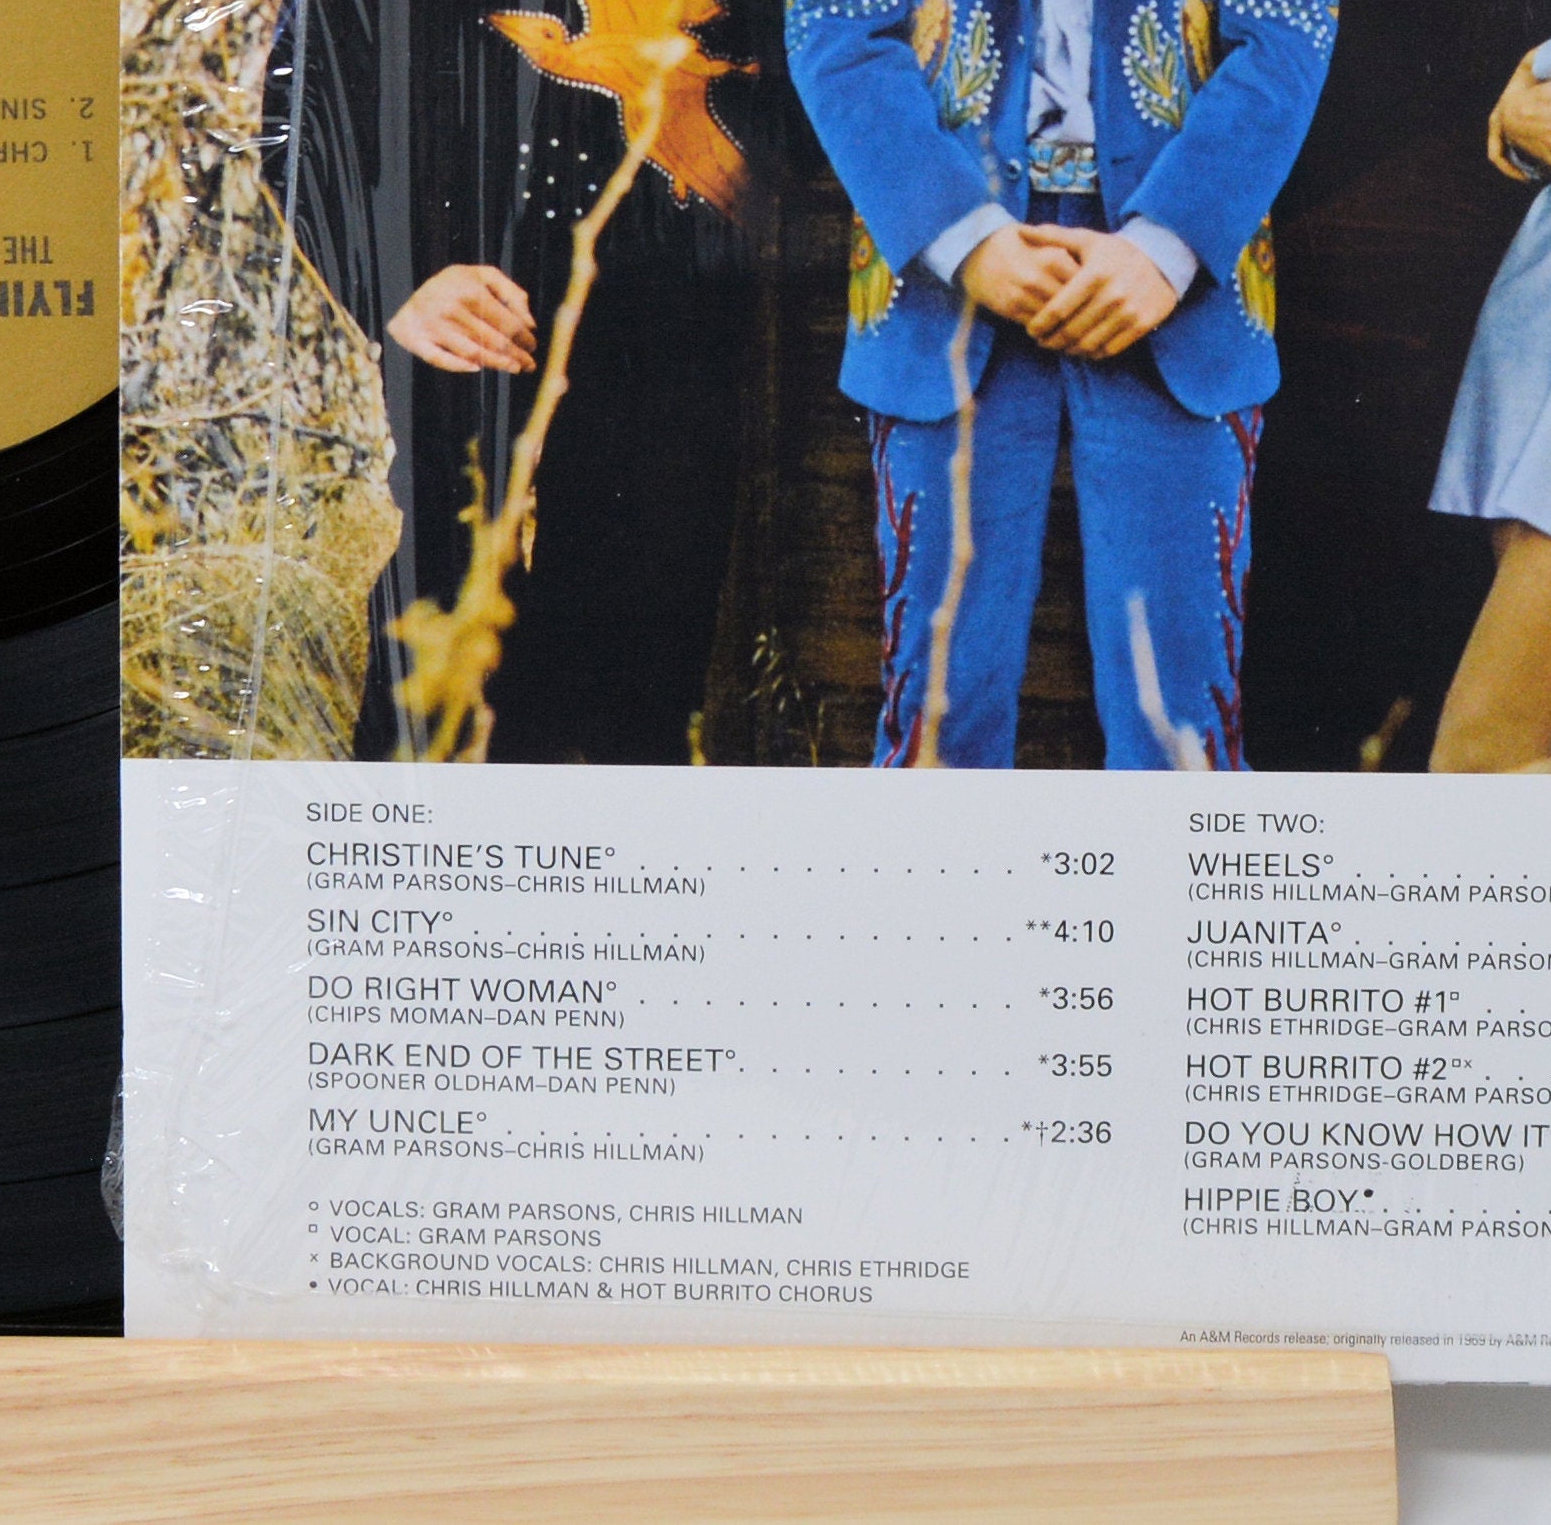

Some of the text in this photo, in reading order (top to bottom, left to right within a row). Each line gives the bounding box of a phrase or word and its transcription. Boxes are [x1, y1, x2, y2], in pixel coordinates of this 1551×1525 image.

[0, 96, 48, 122] SIN
[69, 95, 95, 121] 2.
[71, 139, 95, 164] 1.
[1, 234, 54, 266] THE
[306, 802, 433, 824] SIDE ONE:
[1189, 812, 1325, 834] SIDE TWO:
[307, 841, 504, 869] CHRISTINE'S
[306, 871, 384, 891] (GRAM
[594, 876, 705, 897] HILLMAN)
[307, 908, 359, 933] SIN
[308, 975, 353, 1000] DO
[365, 976, 461, 1002] RIGHT
[1187, 987, 1254, 1012] HOT
[1264, 987, 1404, 1014] BURRITO
[307, 1005, 381, 1024] (CHIPS
[555, 1009, 625, 1030] PENN)
[308, 1041, 395, 1067] DARK
[405, 1043, 471, 1069] END
[481, 1044, 522, 1069] OF
[531, 1045, 593, 1071] THE
[1186, 1054, 1253, 1079] HOT
[1263, 1054, 1403, 1081] BURRITO
[307, 1071, 426, 1091] (SPOONER
[606, 1076, 676, 1097] PENN)
[309, 1107, 358, 1133] MY
[1185, 1120, 1230, 1146] DO
[1240, 1121, 1310, 1147] YOU
[1322, 1122, 1424, 1147] KNOW
[1434, 1123, 1513, 1148] HOW
[1523, 1124, 1551, 1148] IT
[1184, 1150, 1525, 1173] (GRAM PARSONS-GOLDBERG)
[329, 1199, 803, 1225] VOCALS: GRAM PARSONS, CHRIS HILLMAN
[329, 1225, 602, 1248] VOCAL: GRAM PARSONS
[330, 1251, 970, 1279] BACKGROUND VOCALS: CHRIS HILLMAN, CHRIS ETHRIDGE
[414, 1278, 482, 1297] CHRIS
[489, 1280, 589, 1299] HILLMAN
[596, 1281, 614, 1299] &
[620, 1282, 667, 1300] HOT
[673, 1283, 772, 1302] BURRITO
[778, 1284, 873, 1304] CHORUS
